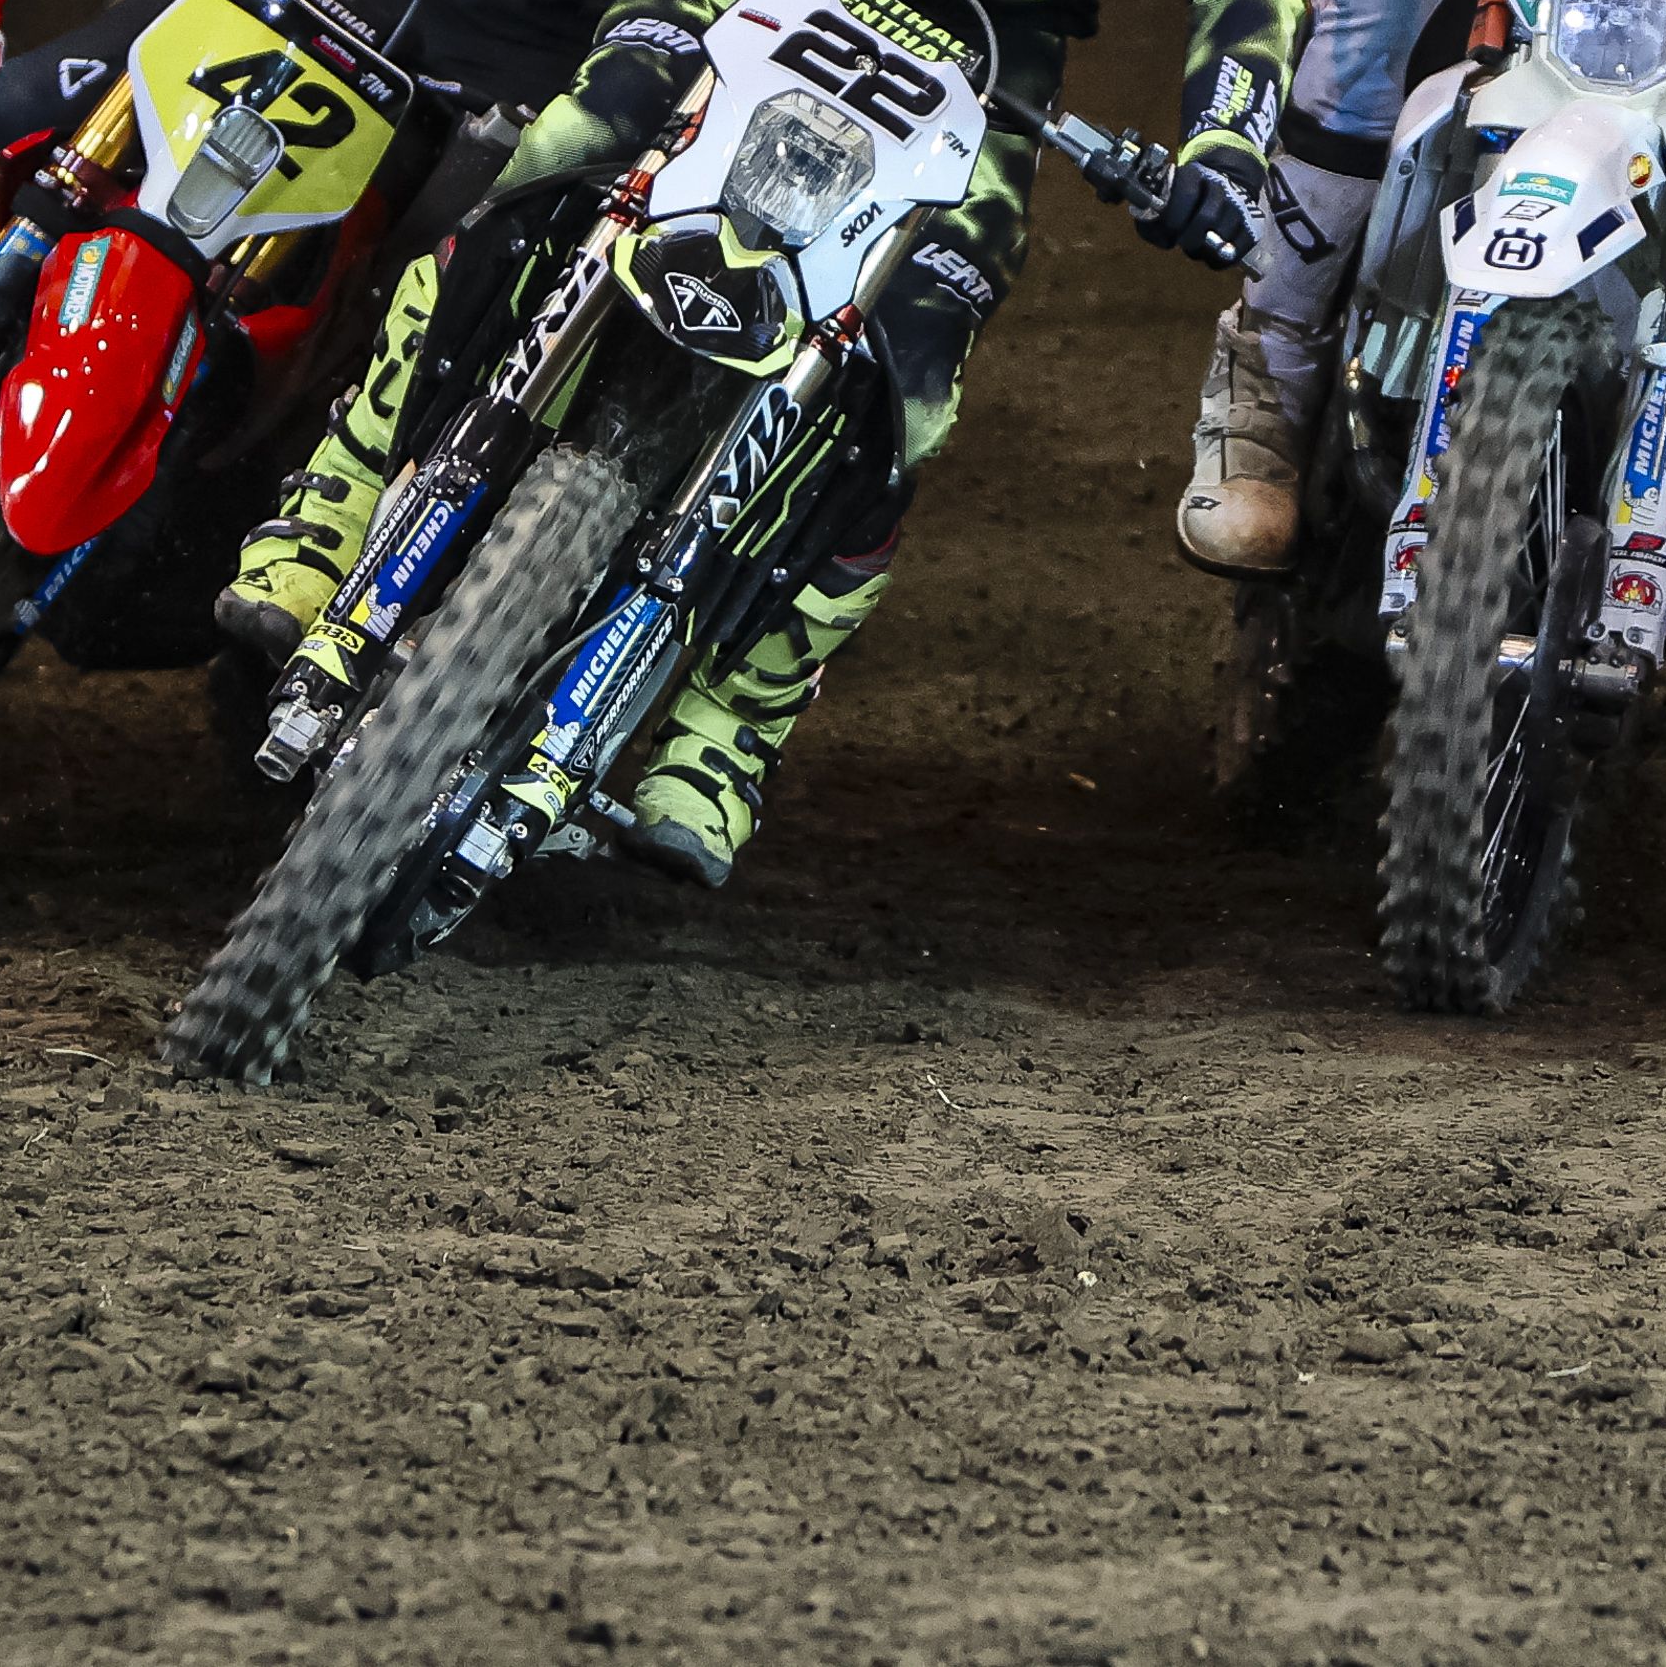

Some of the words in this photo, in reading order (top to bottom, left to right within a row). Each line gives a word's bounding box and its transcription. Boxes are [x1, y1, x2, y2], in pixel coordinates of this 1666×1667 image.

[607, 17, 705, 53] LEATT
[767, 8, 948, 143] 22
[186, 46, 358, 181] 42
[1504, 181, 1569, 199] MOTOREX
[680, 275, 733, 316] TRIUMPH
[913, 243, 997, 303] LEATT
[335, 482, 419, 610] PERFORMANCE
[569, 590, 648, 709] MICHELIN
[594, 614, 674, 746] PERFORMANCE
